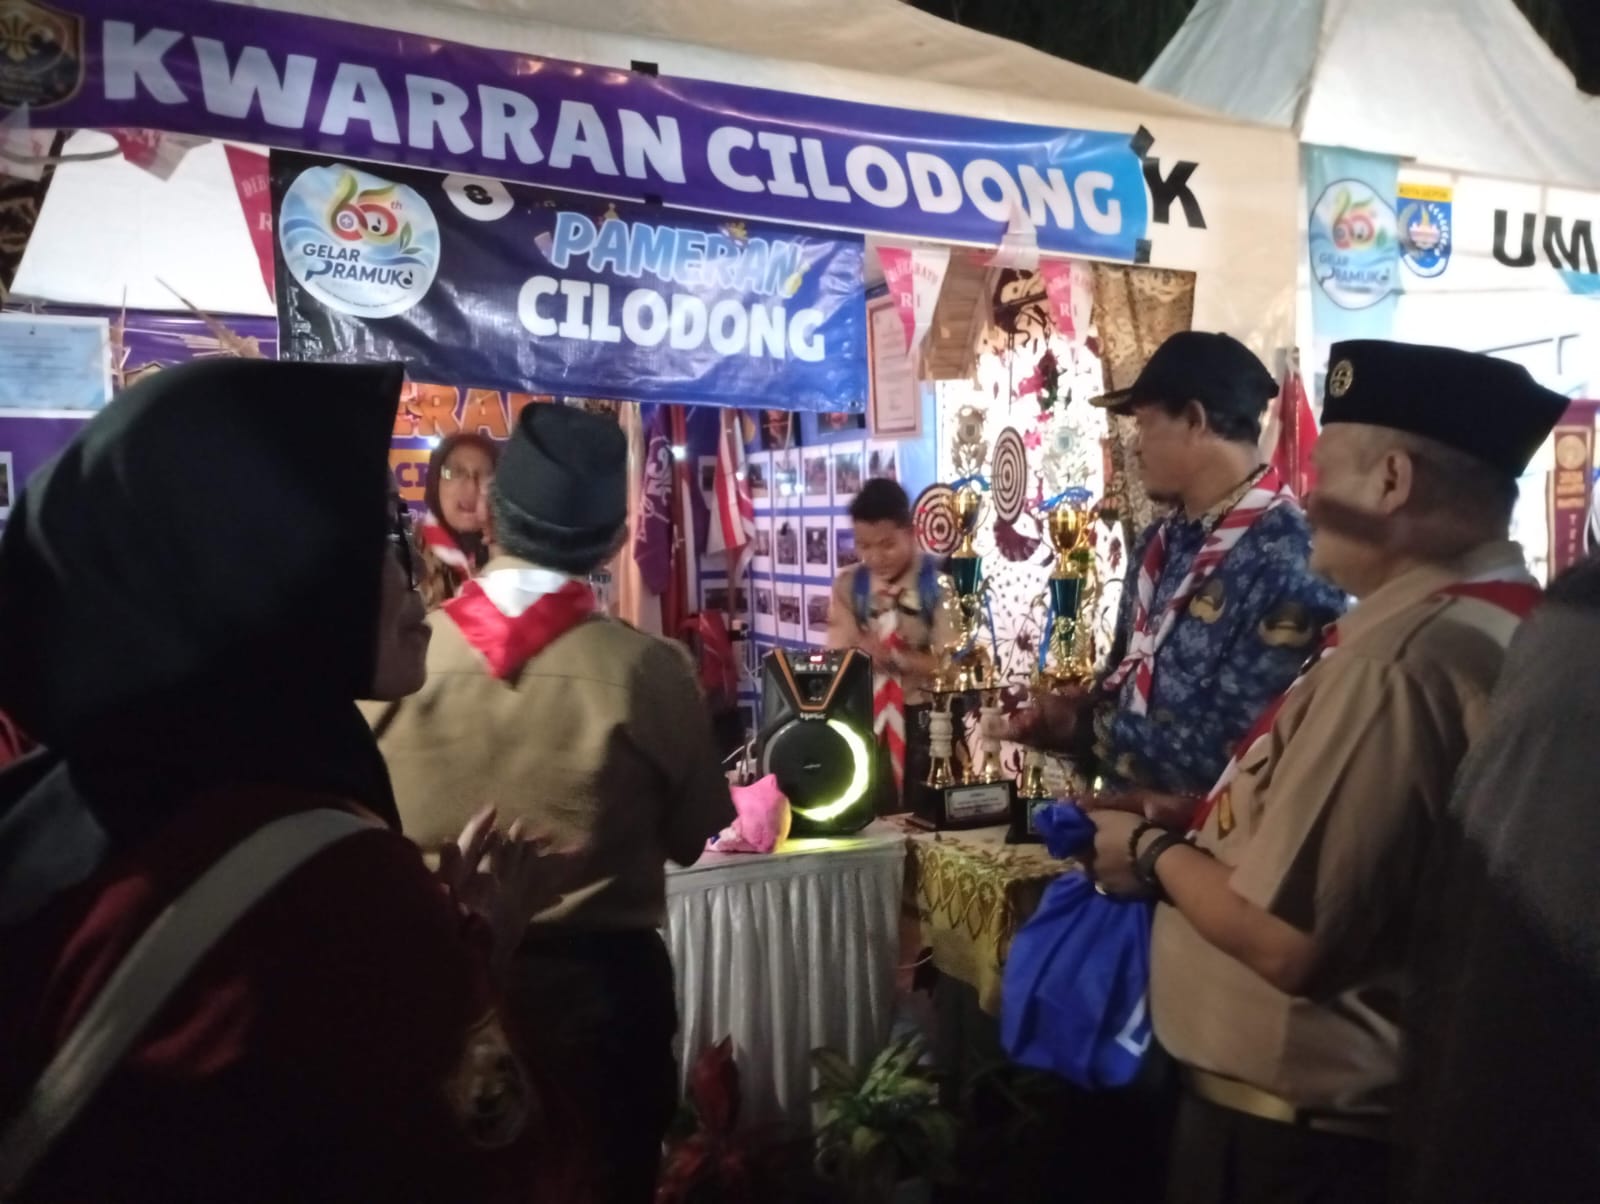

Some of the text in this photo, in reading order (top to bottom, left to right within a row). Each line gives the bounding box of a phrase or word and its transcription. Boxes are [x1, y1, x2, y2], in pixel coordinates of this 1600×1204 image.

[102, 20, 1123, 235] KWARRAN CILODONG
[1143, 156, 1207, 230] K
[302, 242, 361, 262] GELAR
[552, 210, 801, 298] PAMERAN
[1493, 208, 1600, 275] UM
[517, 275, 827, 363] CILODONG
